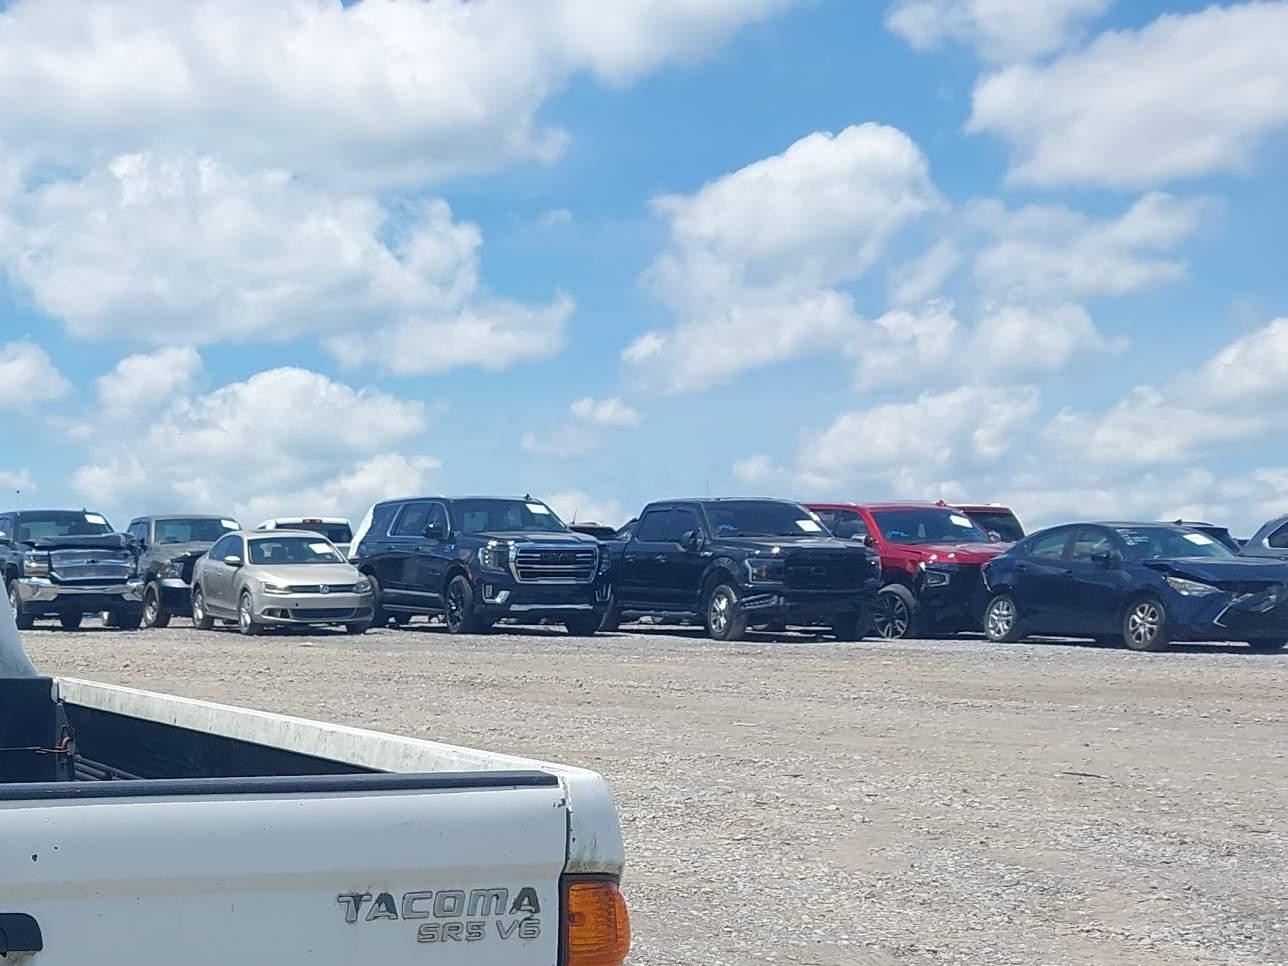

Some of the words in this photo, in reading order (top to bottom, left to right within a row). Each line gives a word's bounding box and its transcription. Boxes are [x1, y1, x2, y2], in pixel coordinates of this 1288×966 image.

[337, 886, 541, 923] TACOMA
[417, 921, 487, 944] SR5
[495, 917, 541, 940] V6
